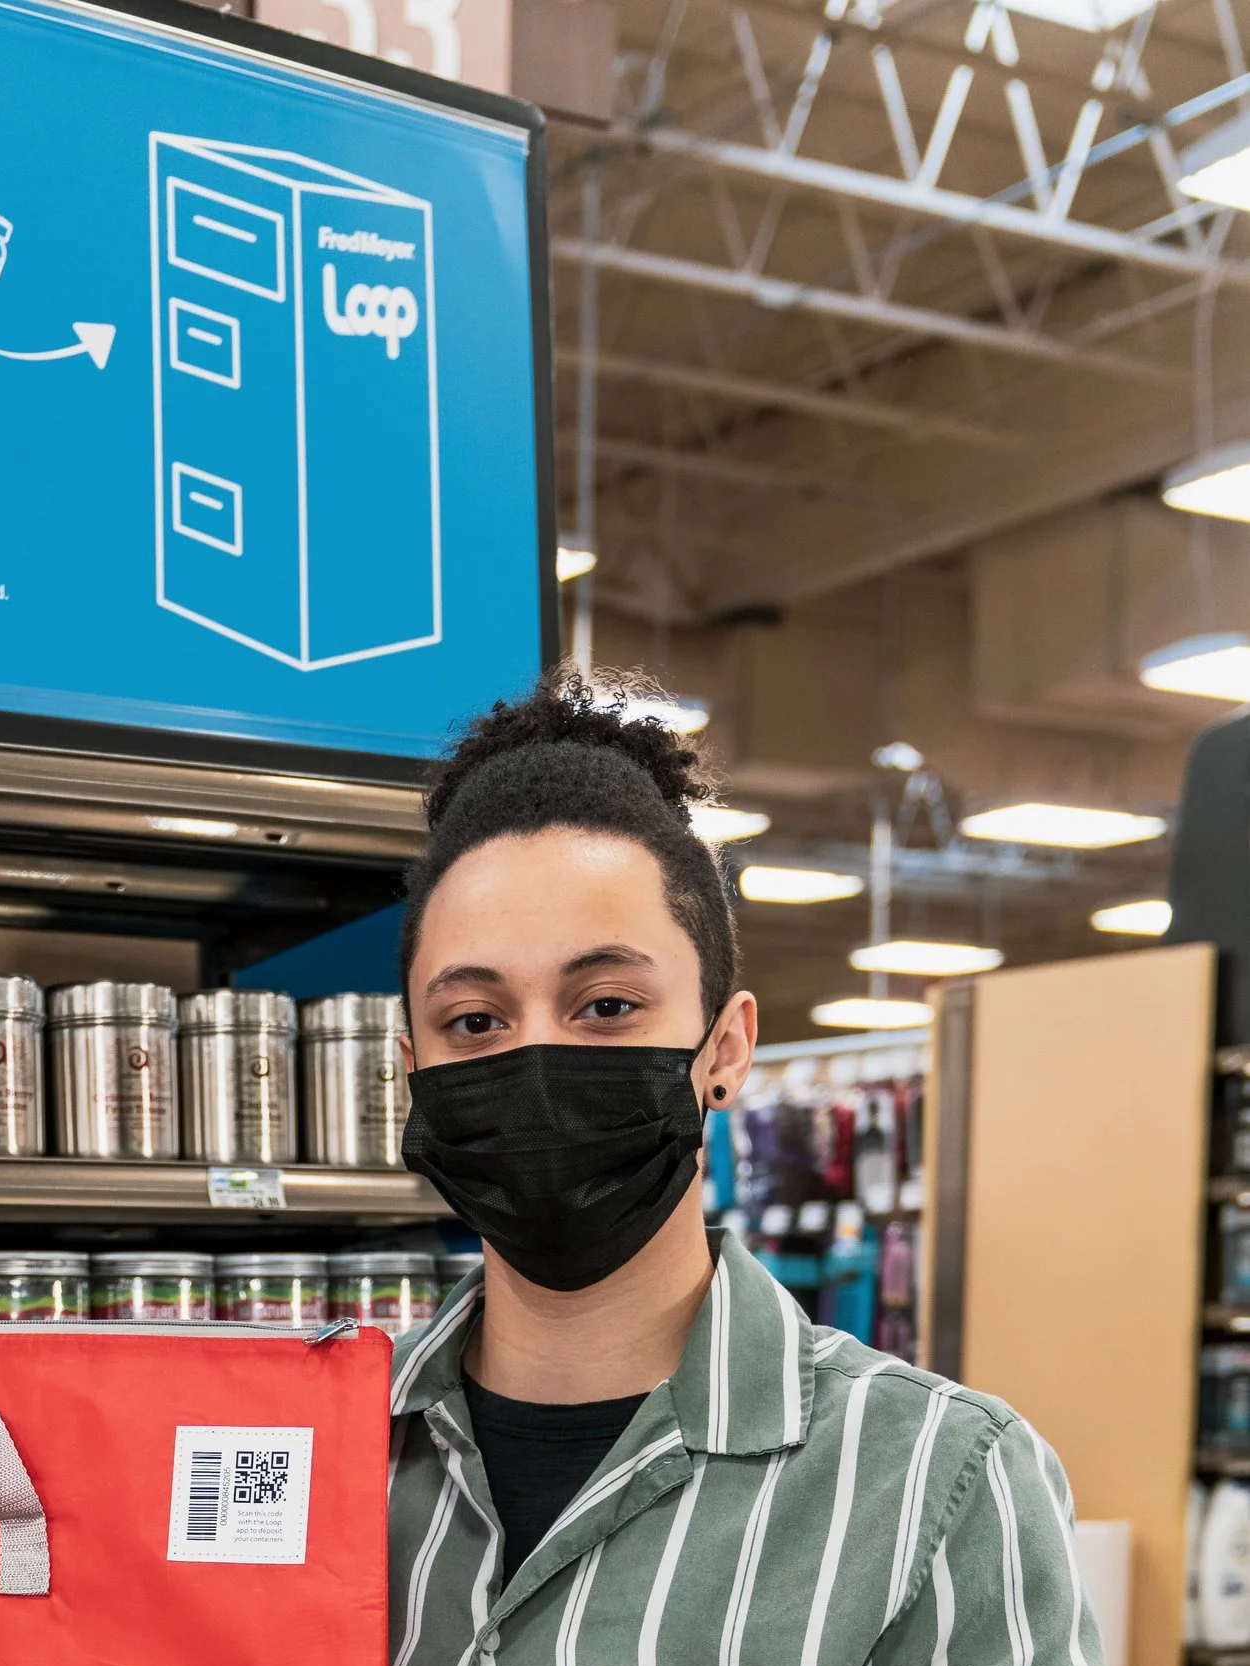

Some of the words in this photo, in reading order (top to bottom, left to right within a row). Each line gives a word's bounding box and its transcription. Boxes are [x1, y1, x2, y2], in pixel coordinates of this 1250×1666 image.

[323, 262, 418, 361] Loop
[265, 1519, 282, 1528] Loop
[236, 1528, 249, 1536] app
[258, 1527, 283, 1536] deposit
